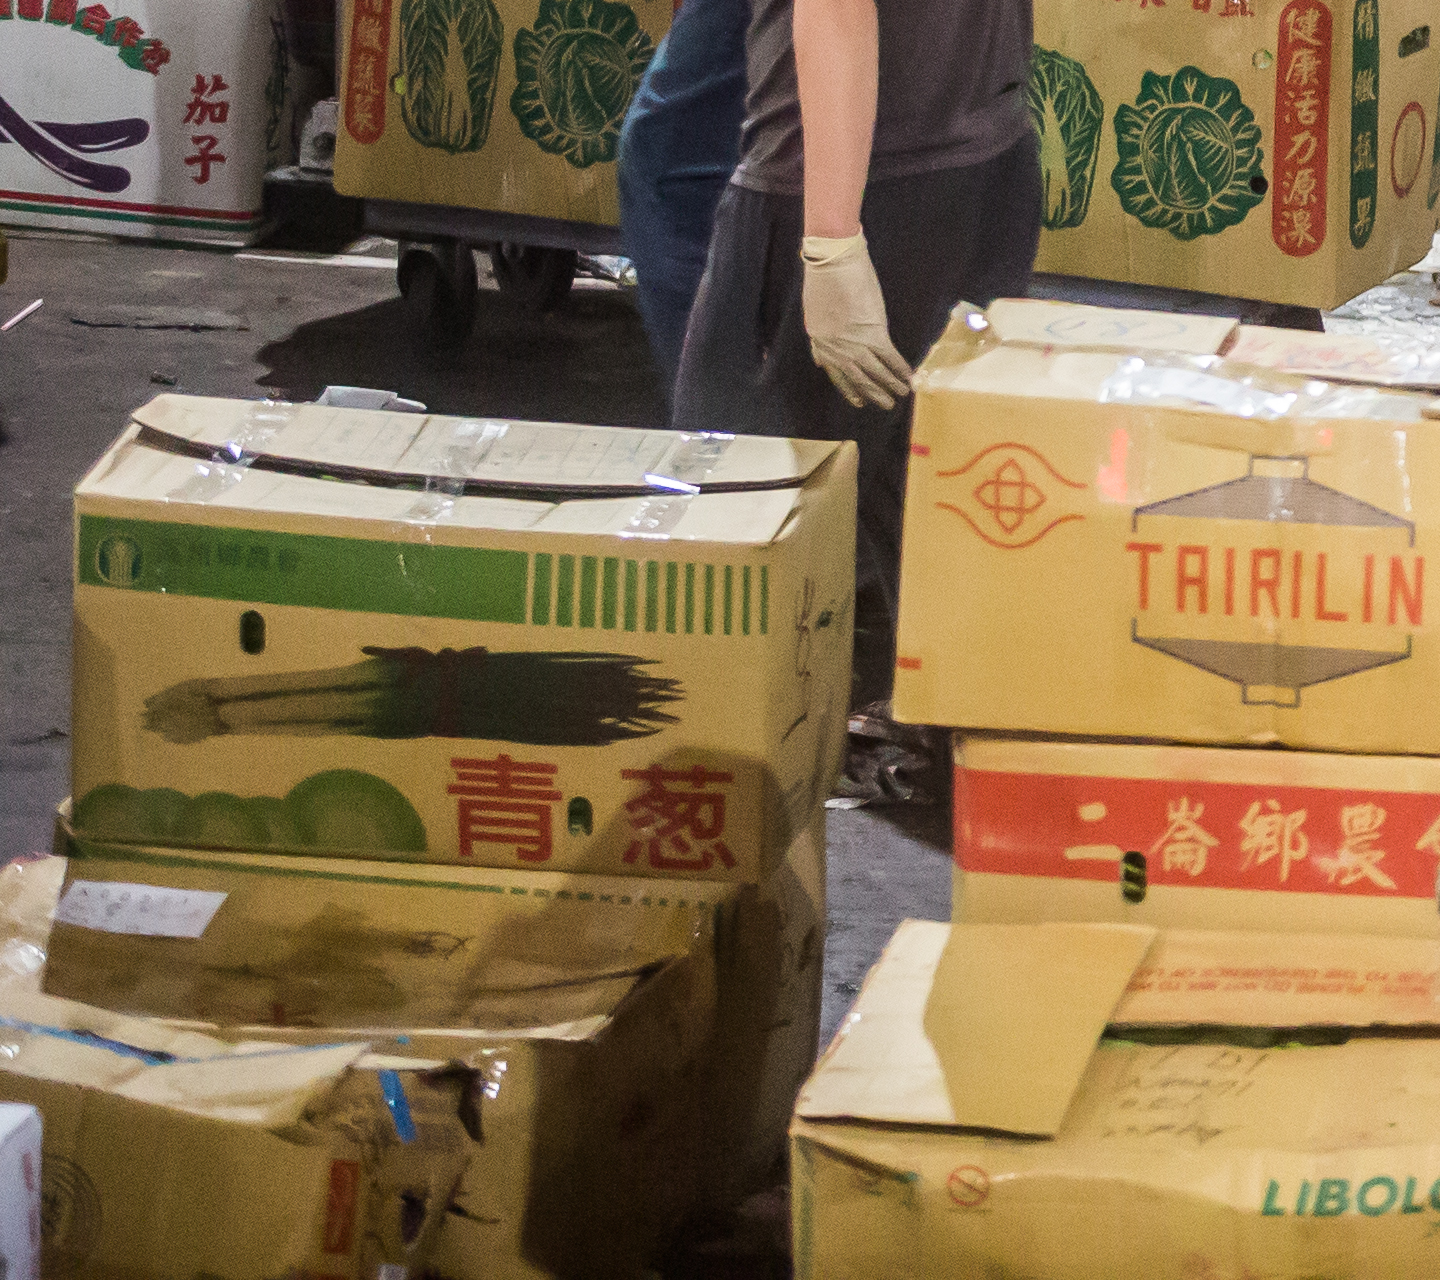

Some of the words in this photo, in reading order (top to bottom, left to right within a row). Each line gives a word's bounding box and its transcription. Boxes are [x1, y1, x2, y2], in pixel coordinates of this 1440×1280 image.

[183, 73, 231, 186] 茄子
[1353, 0, 1377, 239] 精緻蔬果
[1124, 542, 1427, 627] TAIRILIN
